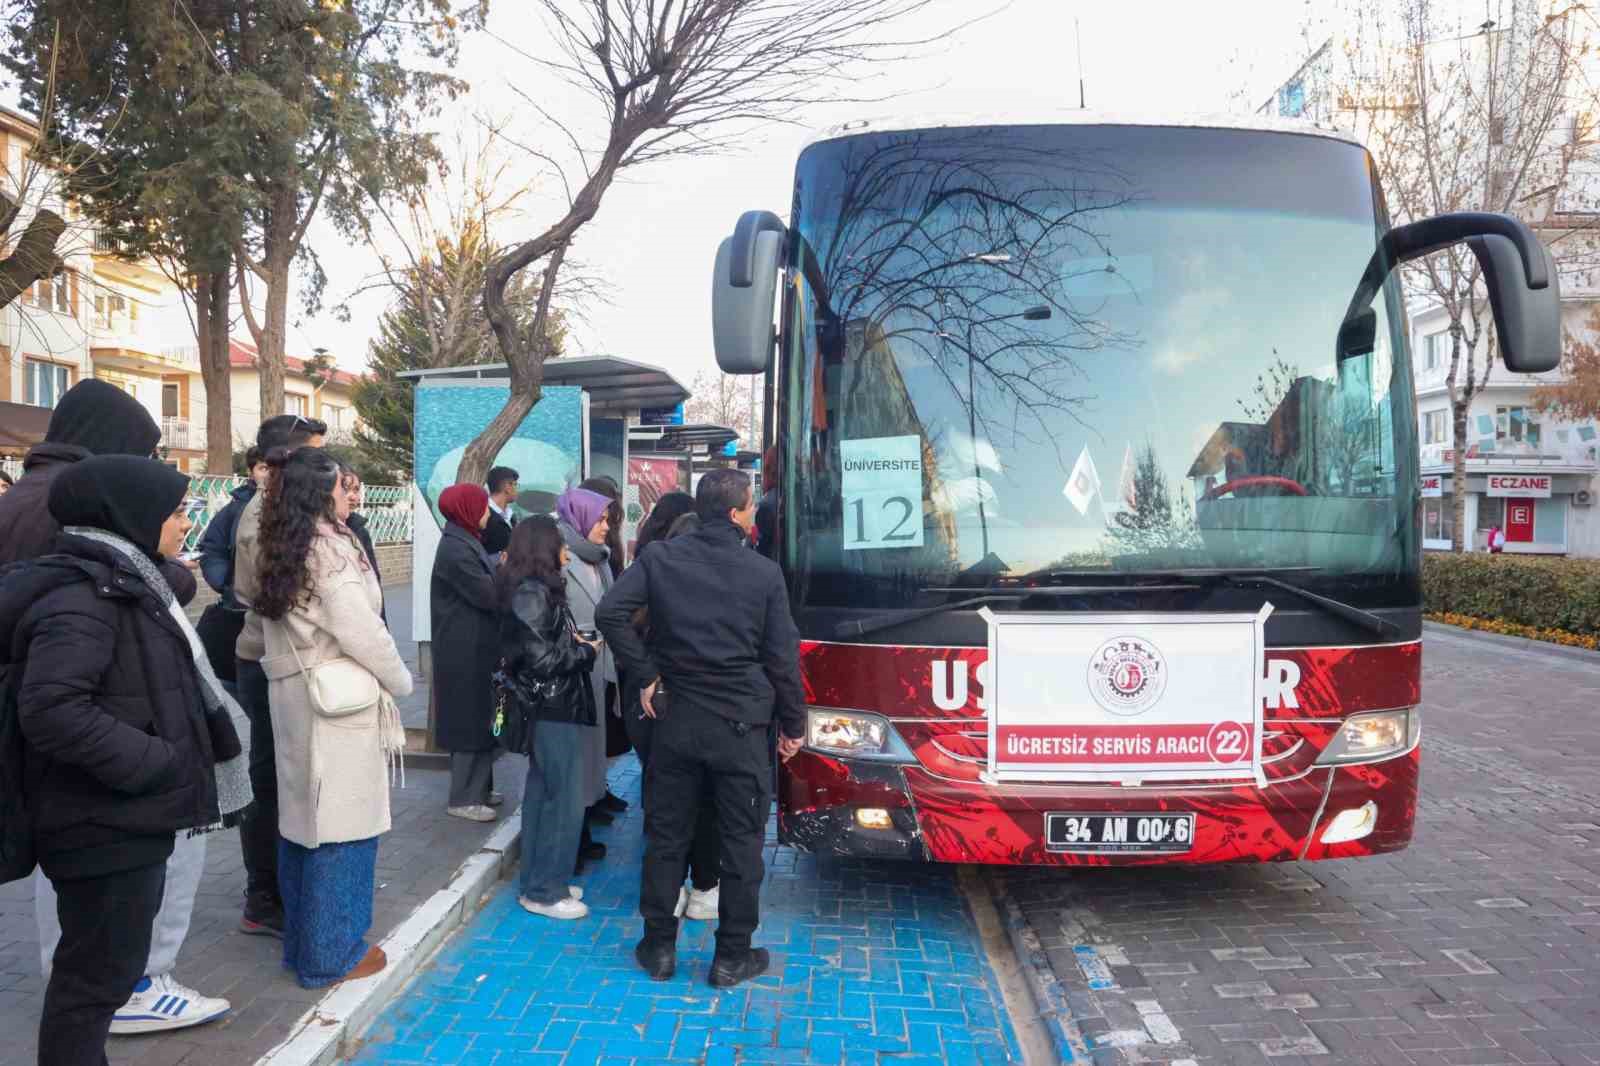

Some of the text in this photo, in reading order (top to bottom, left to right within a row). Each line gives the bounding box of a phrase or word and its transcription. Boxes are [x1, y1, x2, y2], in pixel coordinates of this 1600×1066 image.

[1491, 478, 1548, 489] ECZANE
[847, 496, 918, 543] 12
[1515, 509, 1526, 519] E
[1007, 733, 1205, 756] ÜCRETSİZ SERVİS ARACI
[1216, 730, 1242, 755] 22
[1065, 818, 1092, 842] 34
